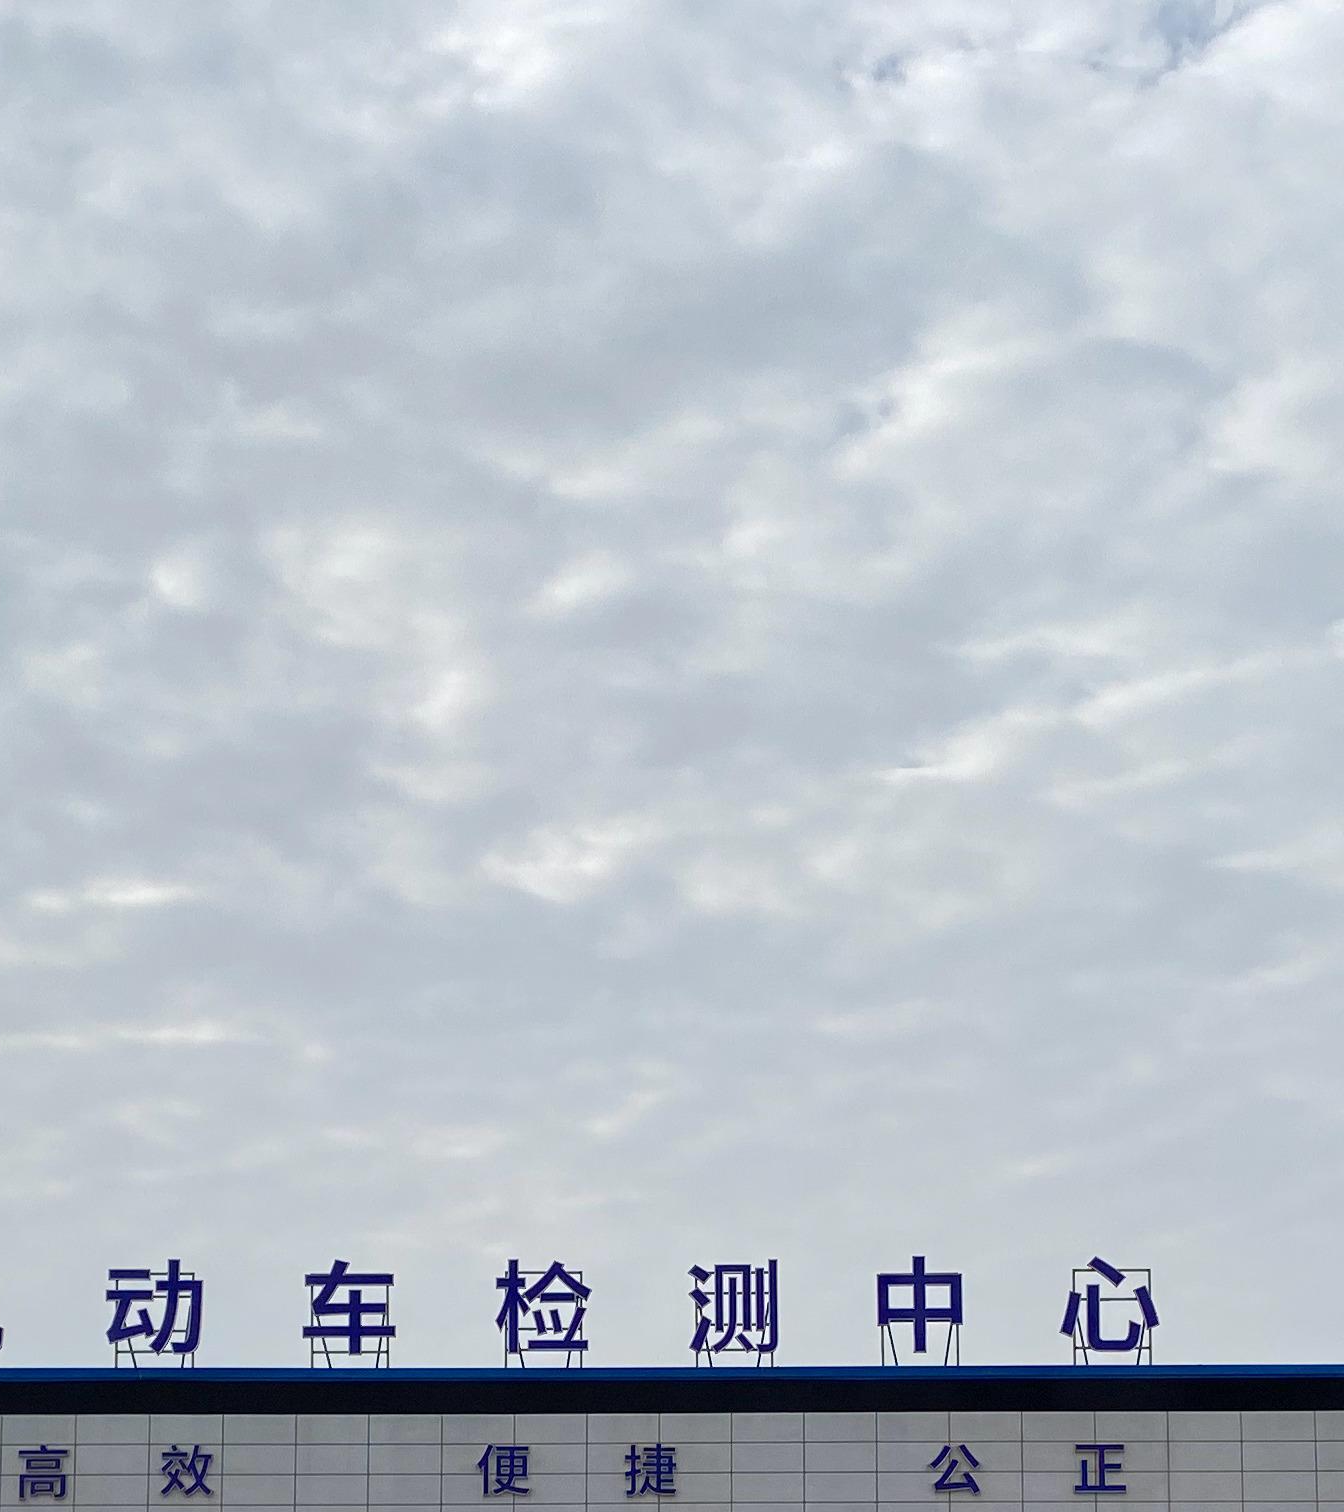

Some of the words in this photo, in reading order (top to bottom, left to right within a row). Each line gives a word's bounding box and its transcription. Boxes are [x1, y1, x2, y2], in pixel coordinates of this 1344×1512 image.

[17, 1445, 213, 1500] 高效
[477, 1444, 677, 1496] 便捷
[929, 1443, 1127, 1494] 公正
